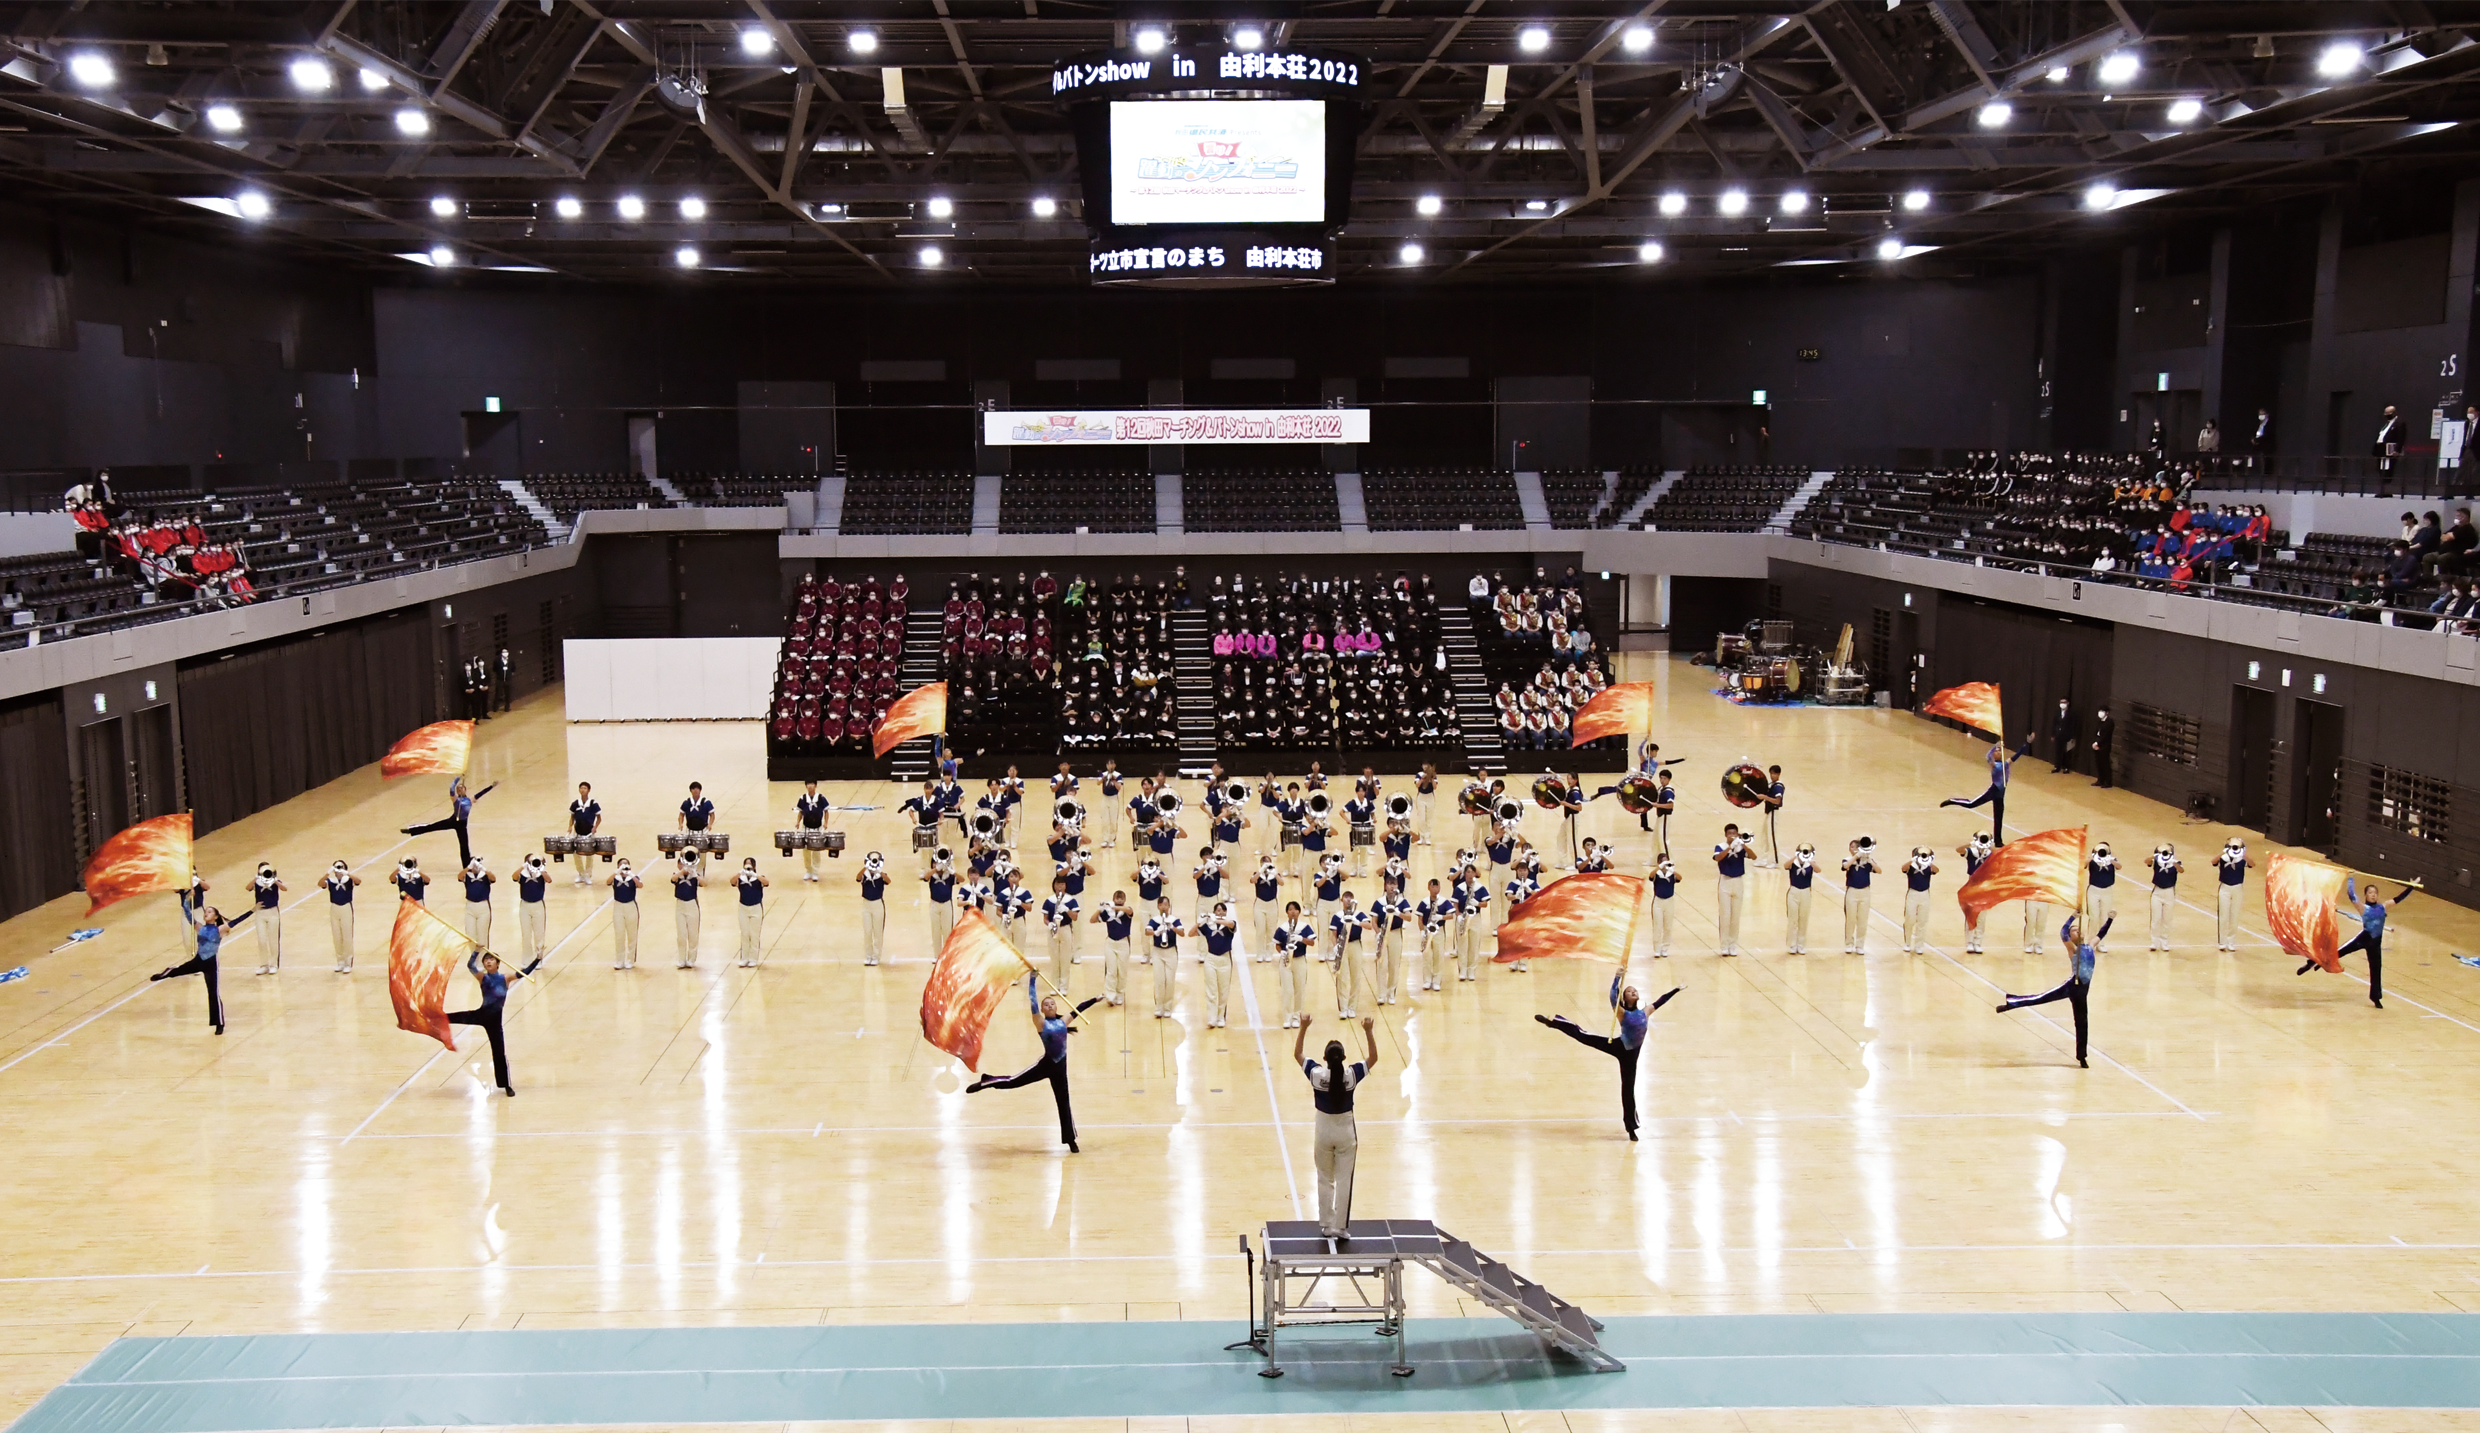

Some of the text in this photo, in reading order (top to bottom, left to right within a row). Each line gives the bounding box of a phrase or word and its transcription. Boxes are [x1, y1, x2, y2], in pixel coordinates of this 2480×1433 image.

[1173, 54, 1195, 77] in
[1220, 52, 1358, 86] 由利本荘2022
[1246, 245, 1323, 270] 由利本荘市
[2440, 353, 2458, 377] 2S
[978, 398, 996, 412] 2E
[1265, 417, 1275, 439] in
[1277, 415, 1312, 439] 由利本荘
[1314, 415, 1342, 439] 2022
